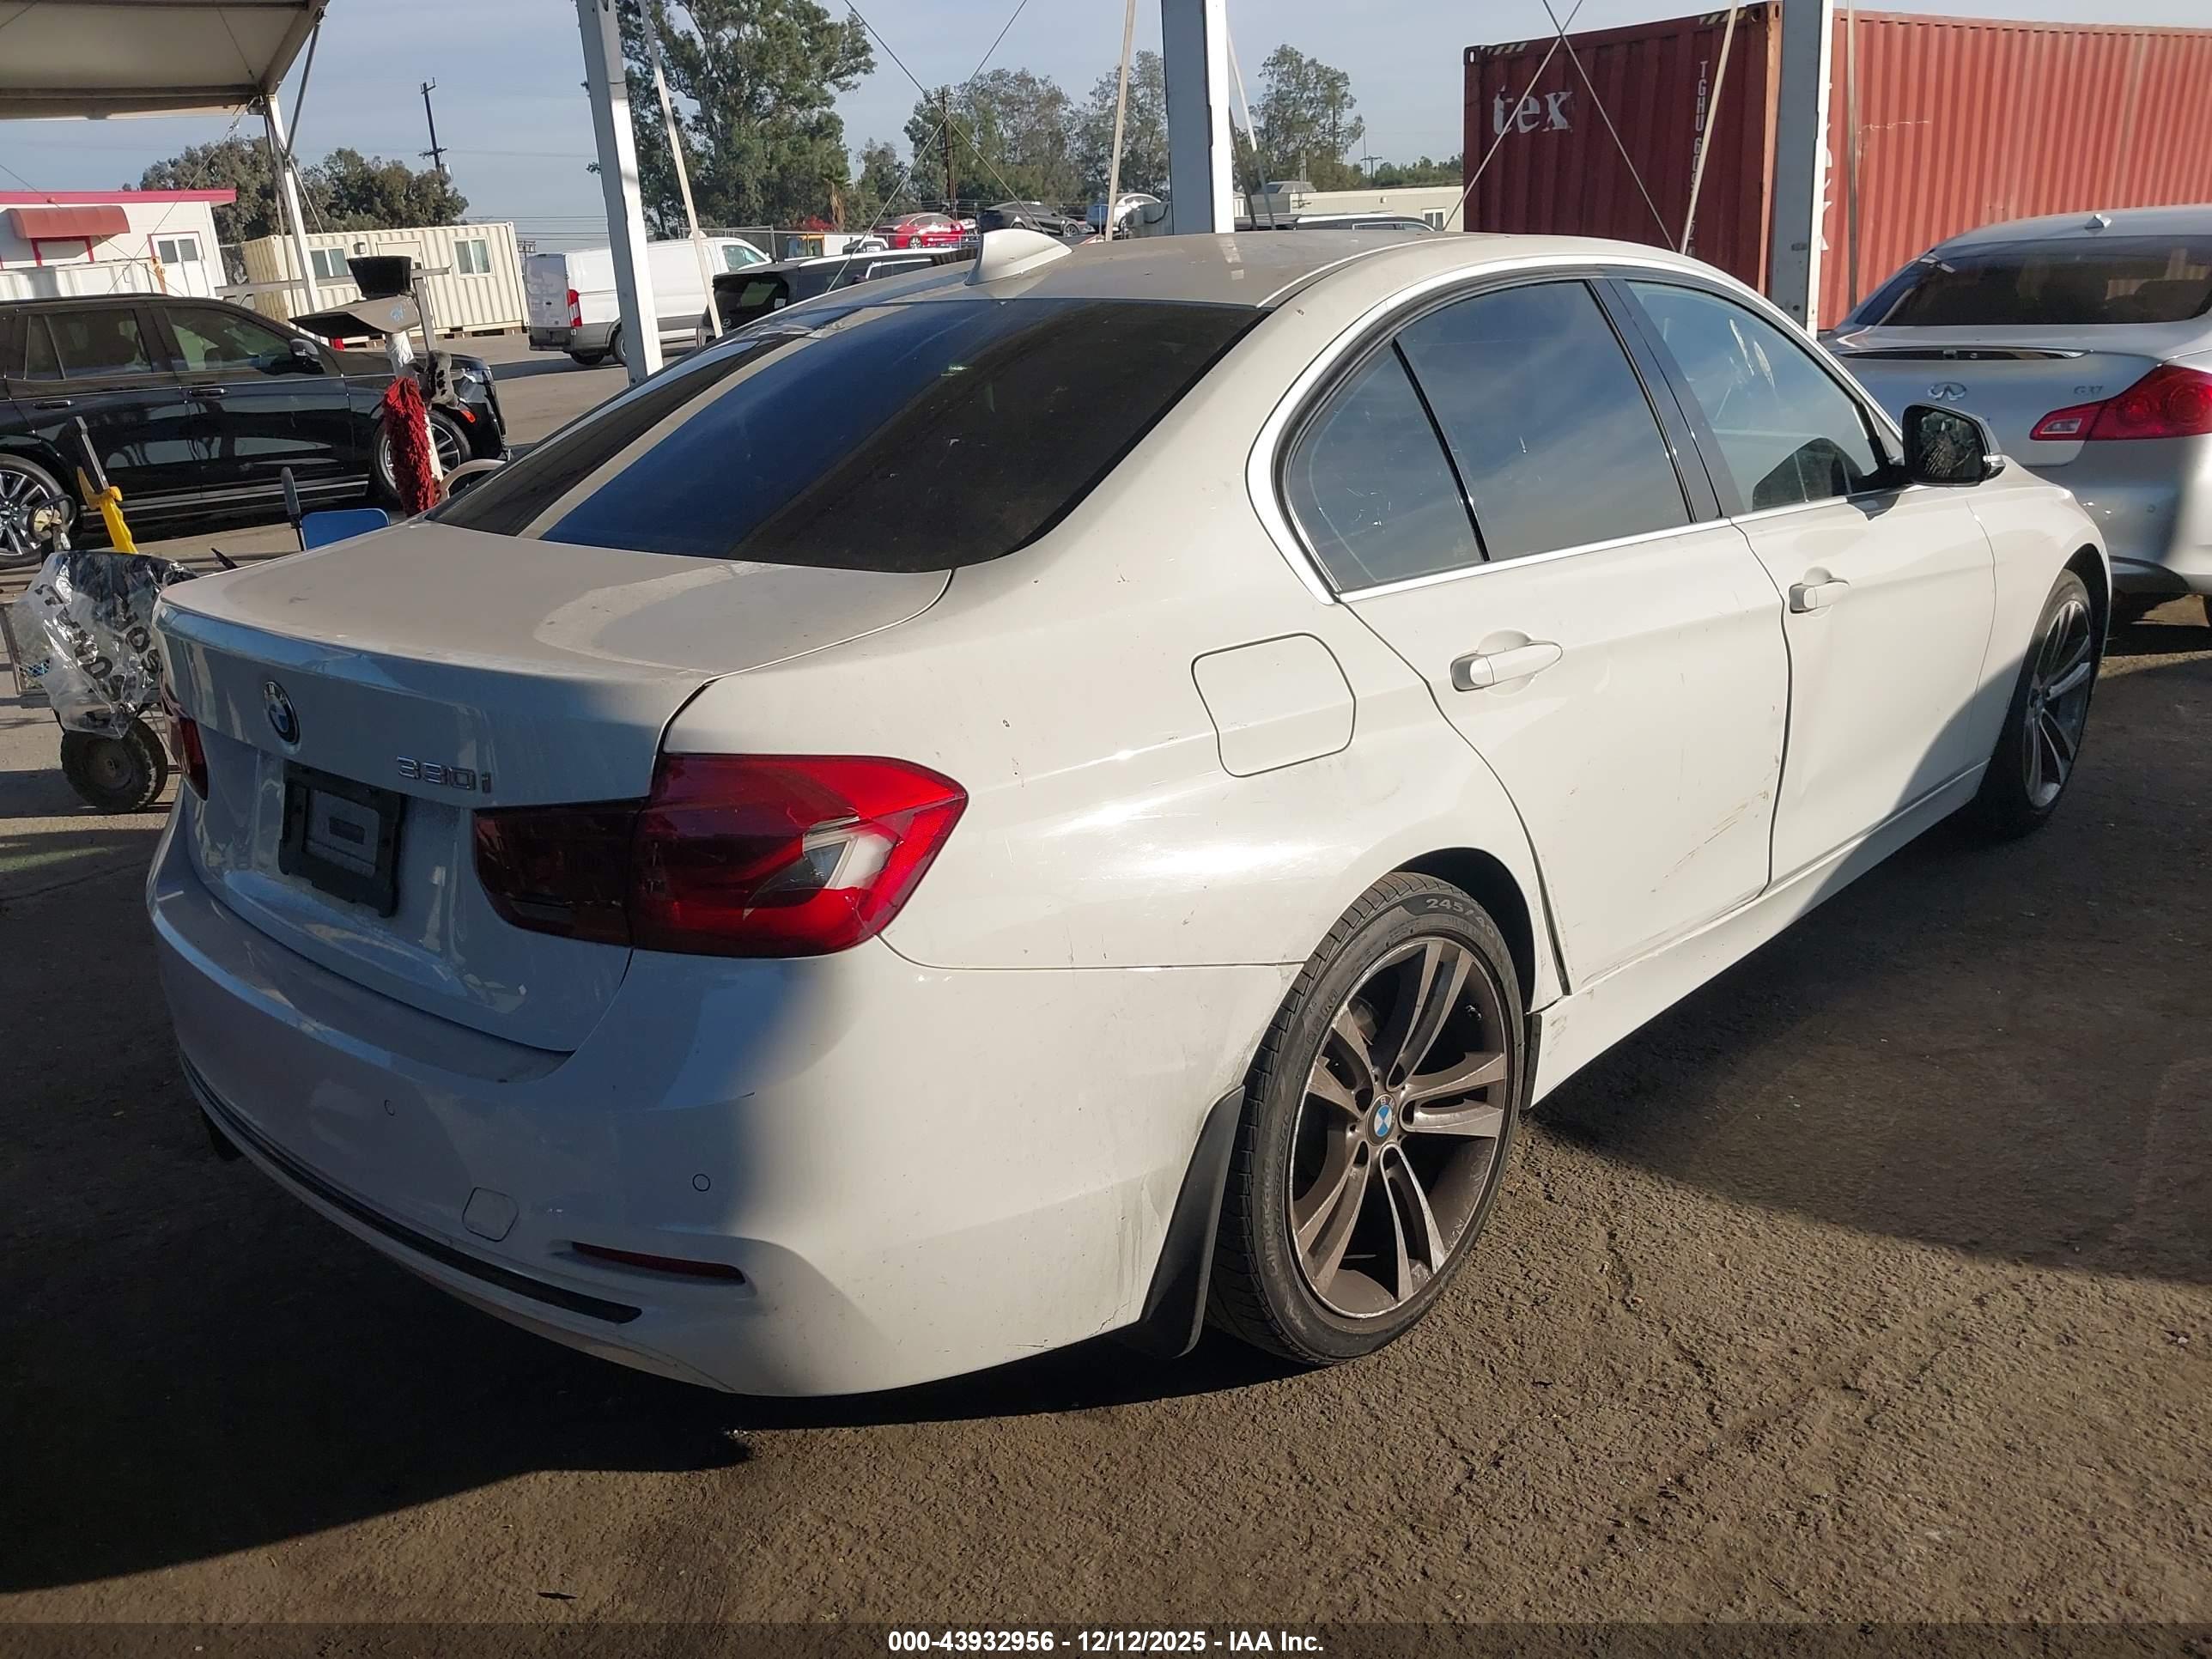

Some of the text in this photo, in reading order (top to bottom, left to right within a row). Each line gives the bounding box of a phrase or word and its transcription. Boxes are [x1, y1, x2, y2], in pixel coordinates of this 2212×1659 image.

[1492, 85, 1573, 135] tex
[1695, 60, 1709, 132] TGHU
[2074, 385, 2103, 397] G37
[397, 756, 492, 793] 330i
[1425, 898, 1496, 937] 245/40
